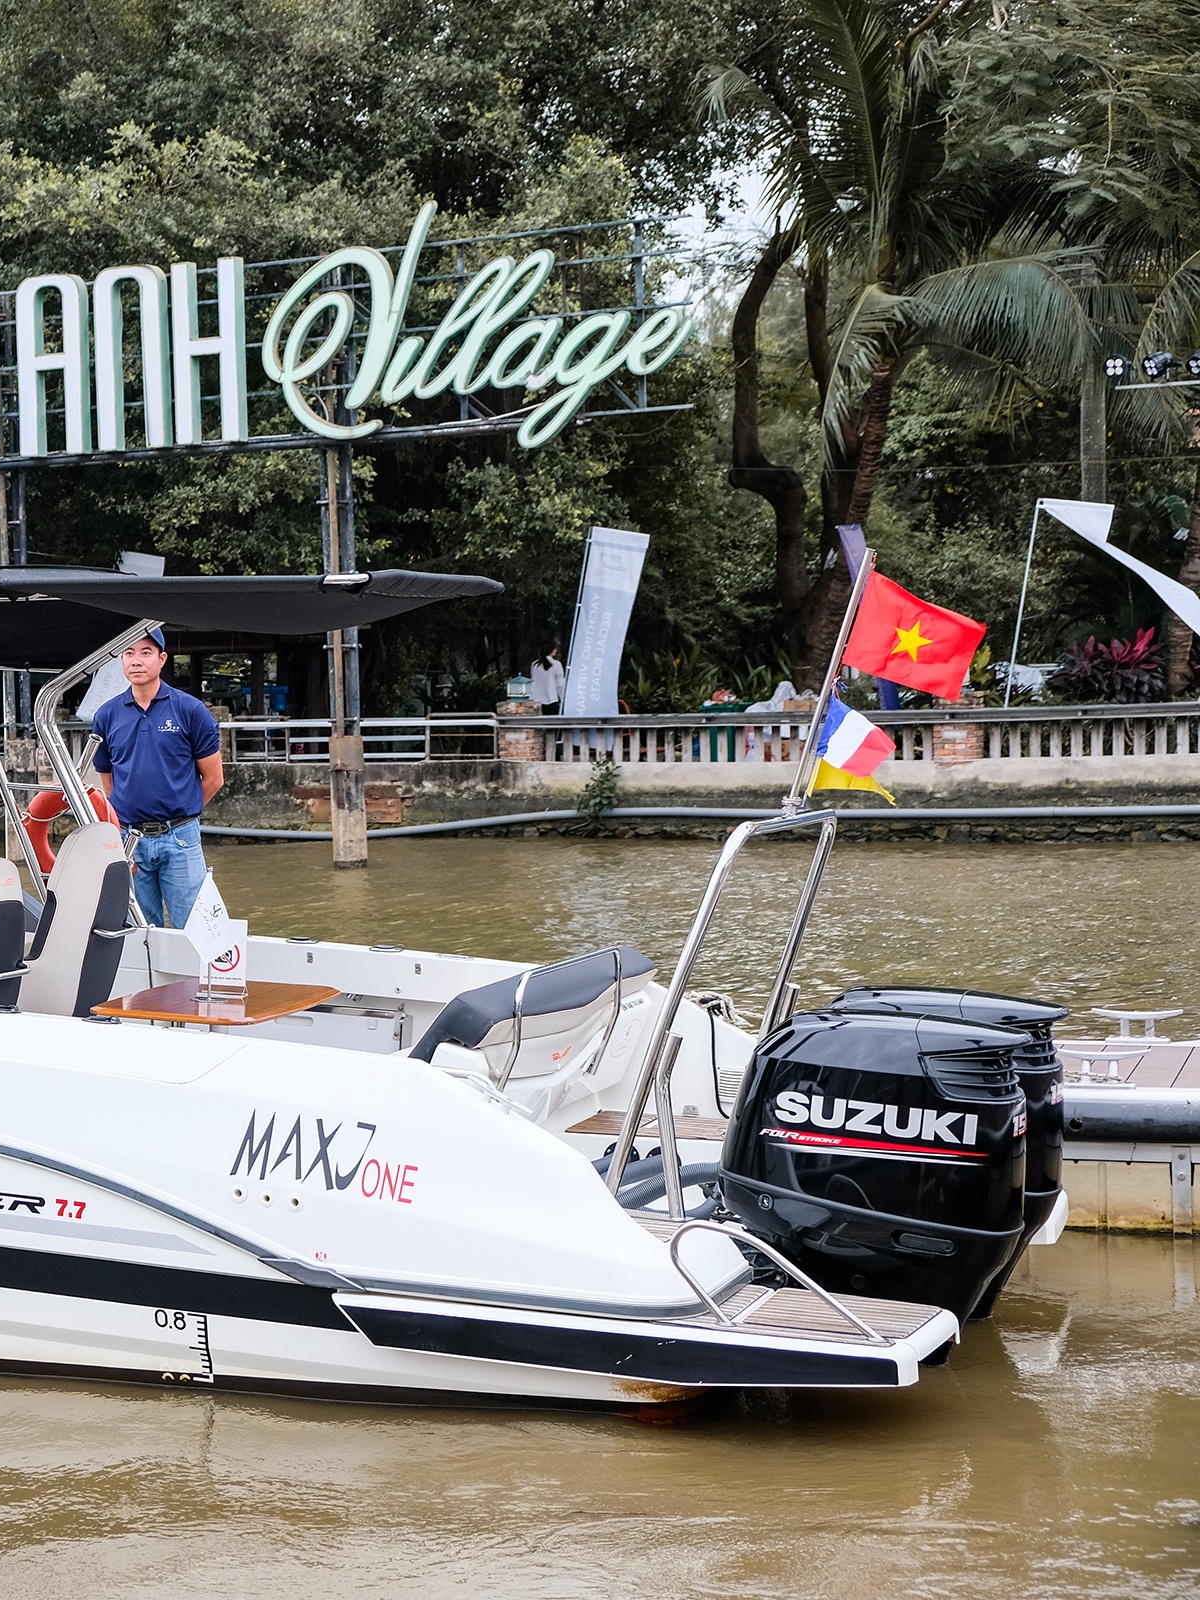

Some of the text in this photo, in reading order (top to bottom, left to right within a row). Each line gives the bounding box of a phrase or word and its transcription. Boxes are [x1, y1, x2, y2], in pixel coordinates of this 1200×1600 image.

[15, 256, 249, 459] ANH
[262, 200, 696, 449] Village
[774, 1091, 979, 1146] SUZUKI
[55, 1198, 87, 1220] 7.7
[154, 1308, 187, 1331] 0.8
